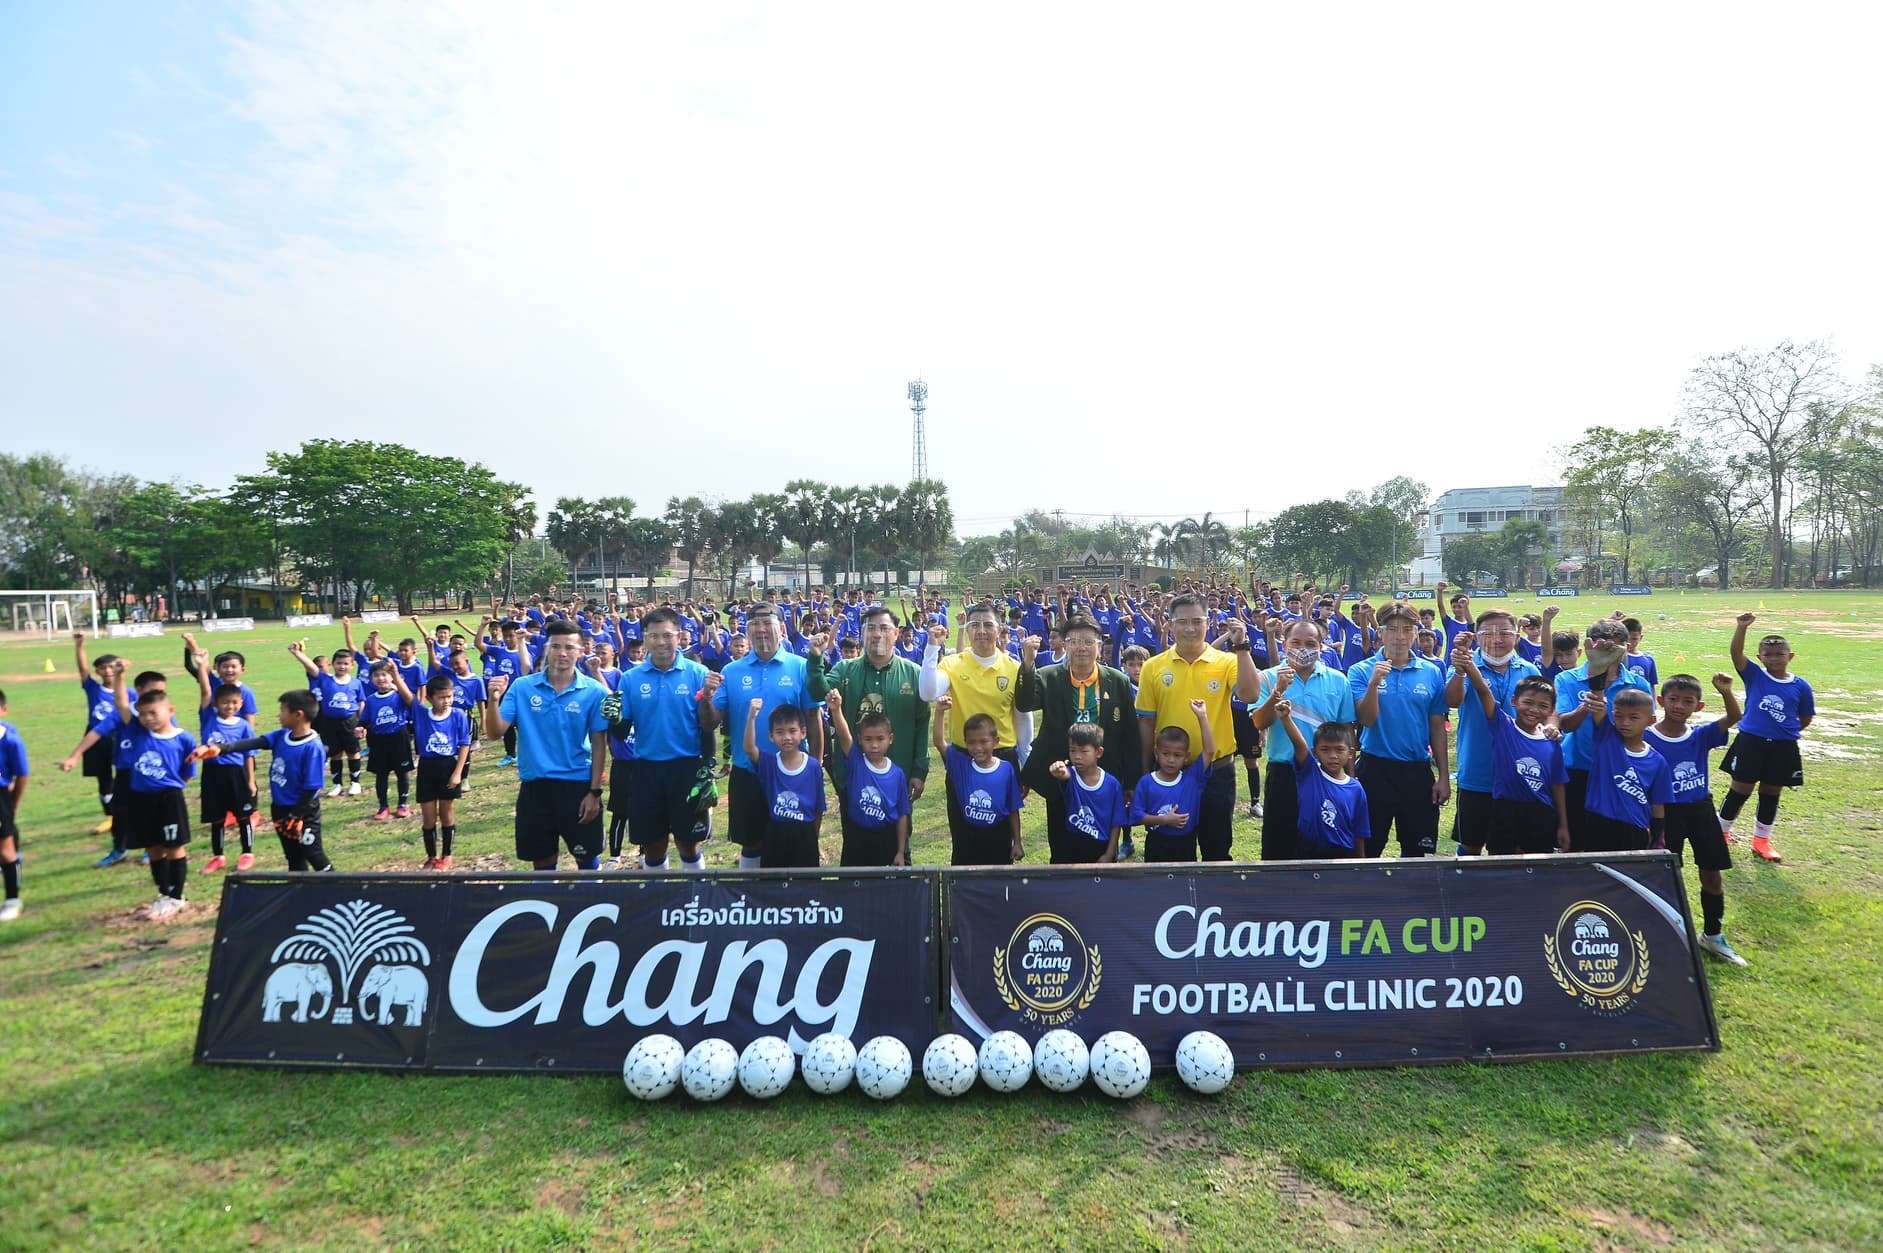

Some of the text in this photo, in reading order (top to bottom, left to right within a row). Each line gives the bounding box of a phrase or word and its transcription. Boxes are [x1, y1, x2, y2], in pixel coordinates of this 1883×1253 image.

[1076, 710, 1090, 723] 23
[964, 805, 997, 824] Chang
[163, 823, 178, 841] 17
[661, 895, 843, 927] เครื่องดื่มตราช้าง
[1154, 904, 1486, 969] Chang FA CUP
[1571, 939, 1619, 957] Chang
[1022, 953, 1072, 972] Chang
[1579, 958, 1619, 971] FA CUP
[448, 899, 877, 1056] Chang
[1026, 972, 1069, 985] FA CUP
[1588, 972, 1615, 984] 2020
[1034, 986, 1063, 998] 2020
[1132, 975, 1523, 1016] FOOTBALL CLINIC 2020
[1582, 991, 1630, 1010] 50 YEARS
[1023, 1007, 1075, 1025] 50 YEARS
